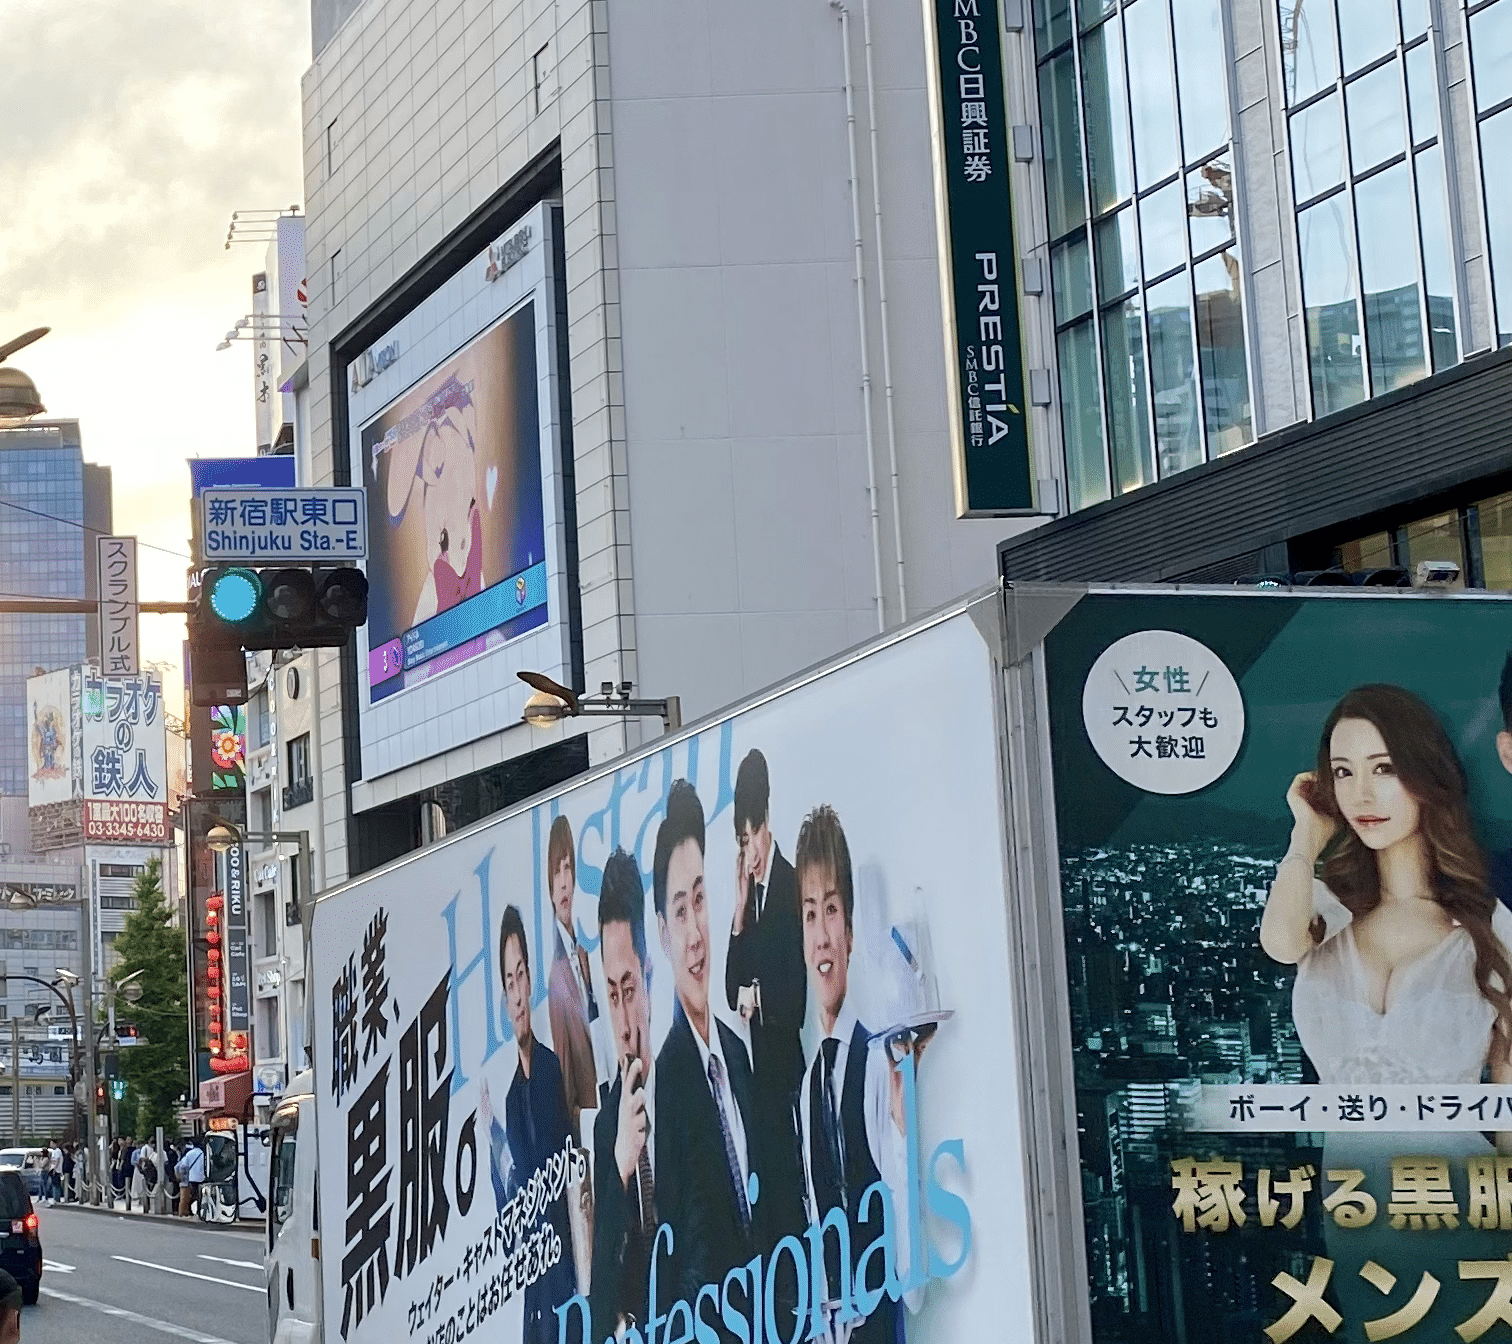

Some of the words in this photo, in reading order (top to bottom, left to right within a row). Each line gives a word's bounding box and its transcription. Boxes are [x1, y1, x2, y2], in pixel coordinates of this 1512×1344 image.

[208, 497, 358, 527] 新宿駅東口
[207, 530, 292, 555] Shinjuku
[107, 541, 132, 674] スクランブル式
[85, 669, 162, 727] カラオケ
[1133, 665, 1191, 695] 女性
[1112, 705, 1219, 729] スタッフも
[1129, 735, 1206, 760] 大歓迎
[90, 748, 159, 799] 鉄人
[229, 843, 242, 916] OO&RIKU
[332, 906, 400, 1108] 職業、
[340, 965, 478, 1344] 黒服。
